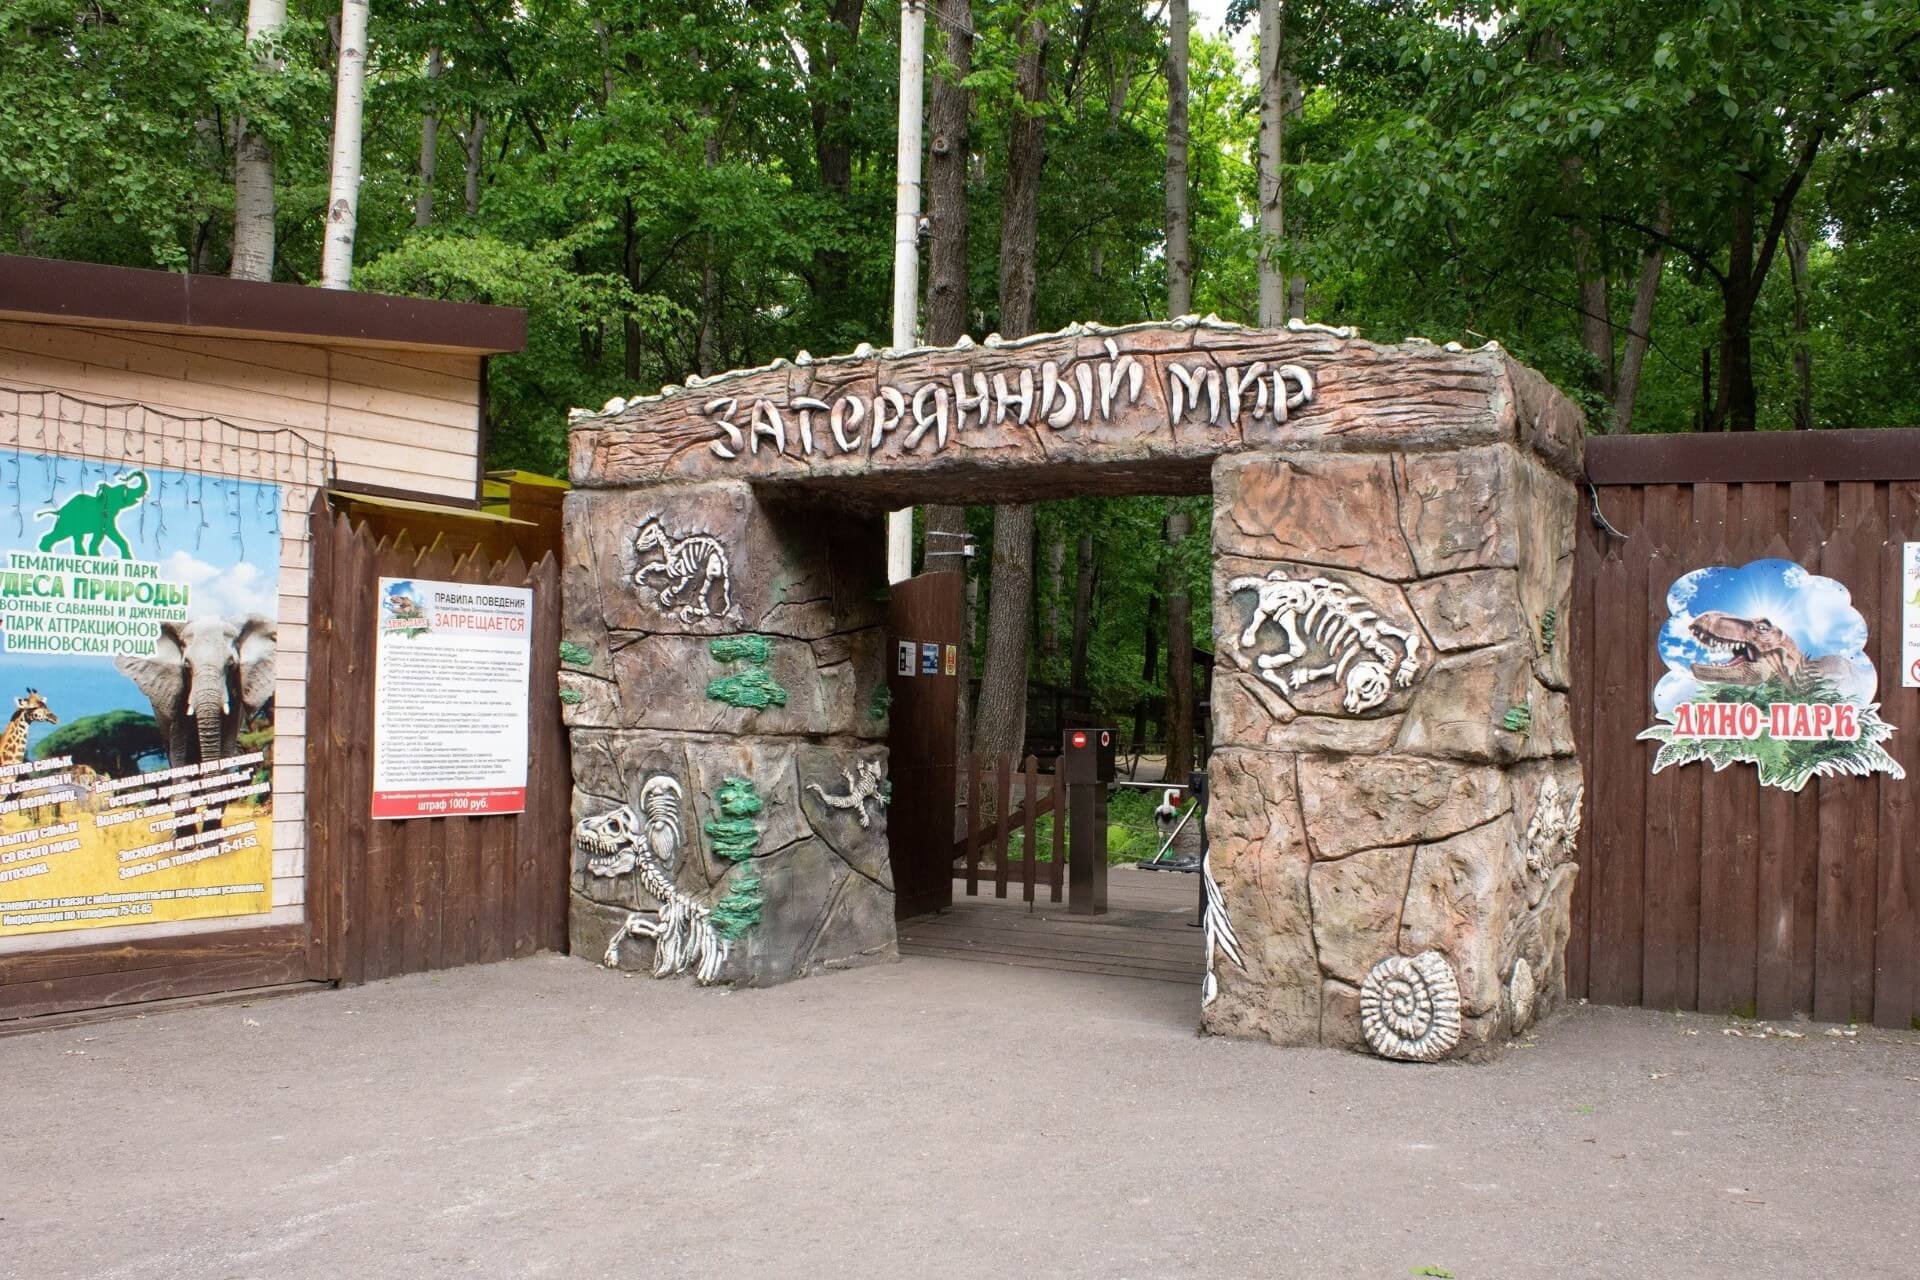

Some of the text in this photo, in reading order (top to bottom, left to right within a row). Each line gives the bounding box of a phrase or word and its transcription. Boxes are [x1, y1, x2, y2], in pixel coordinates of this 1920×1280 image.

[1167, 360, 1314, 426] МИР
[10, 554, 158, 579] ТЕМАТИЧЕСКИЙ ПАРК
[0, 571, 189, 607] ДЕСА ПРИРОДЫ
[434, 592, 525, 609] ПРАВИЛА ПОВЕДЕНИЯ
[56, 602, 114, 617] САВАННЫ
[118, 606, 126, 616] И
[129, 606, 187, 621] ДЖУНГЛЕЙ
[6, 615, 159, 638] ПАРК АТТРАКЦИОНОВ
[434, 612, 525, 633] ЗАПРЕЩАЕТСЯ
[8, 634, 156, 655] ВИННОВСКАЯ РОЩА
[1672, 703, 1856, 738] ДИНО-ПАРК
[34, 755, 73, 771] самых
[11, 774, 63, 793] саванны
[63, 773, 72, 784] и
[136, 808, 143, 819] с
[417, 797, 489, 812] штраф 1000 руб.
[40, 821, 79, 838] самых
[2, 838, 82, 863] со всего мира.
[175, 837, 195, 850] для
[119, 862, 158, 880] Запись
[158, 859, 170, 869] по
[171, 846, 219, 867] телефону
[52, 898, 59, 907] в
[60, 896, 86, 907] связи
[87, 896, 93, 905] с
[64, 910, 76, 920] по
[76, 907, 118, 919] телефону
[120, 903, 153, 915] 75-41-65
